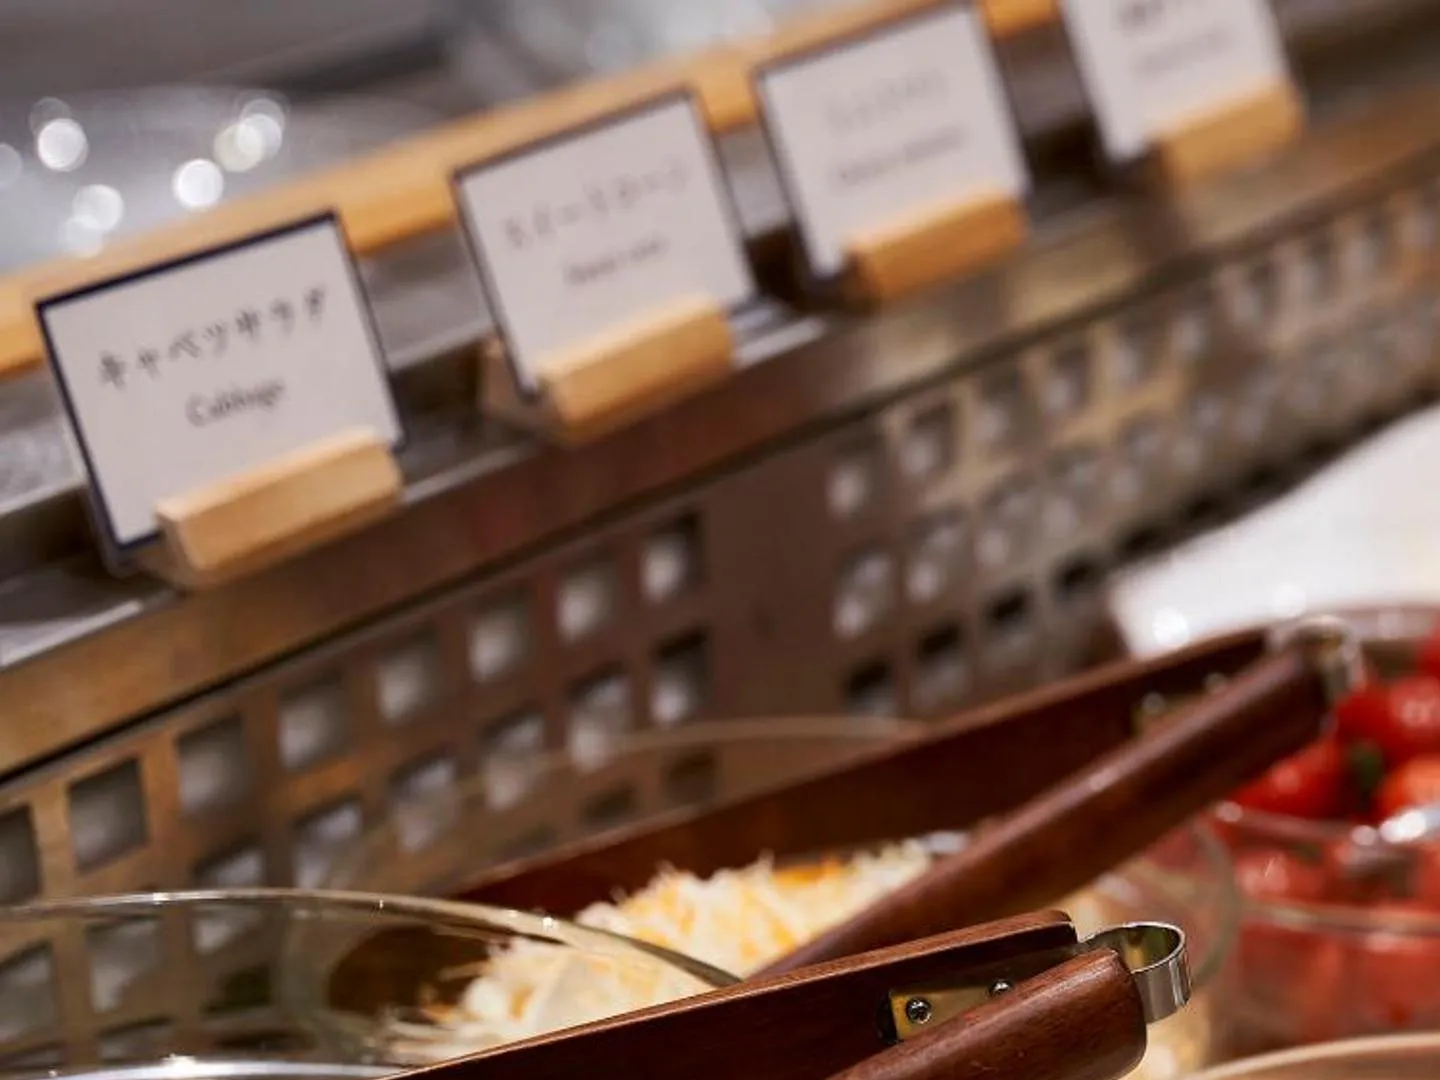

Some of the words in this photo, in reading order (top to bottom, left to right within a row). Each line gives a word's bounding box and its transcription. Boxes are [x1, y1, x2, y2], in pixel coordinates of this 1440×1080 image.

[99, 287, 326, 389] キャベツサラダ
